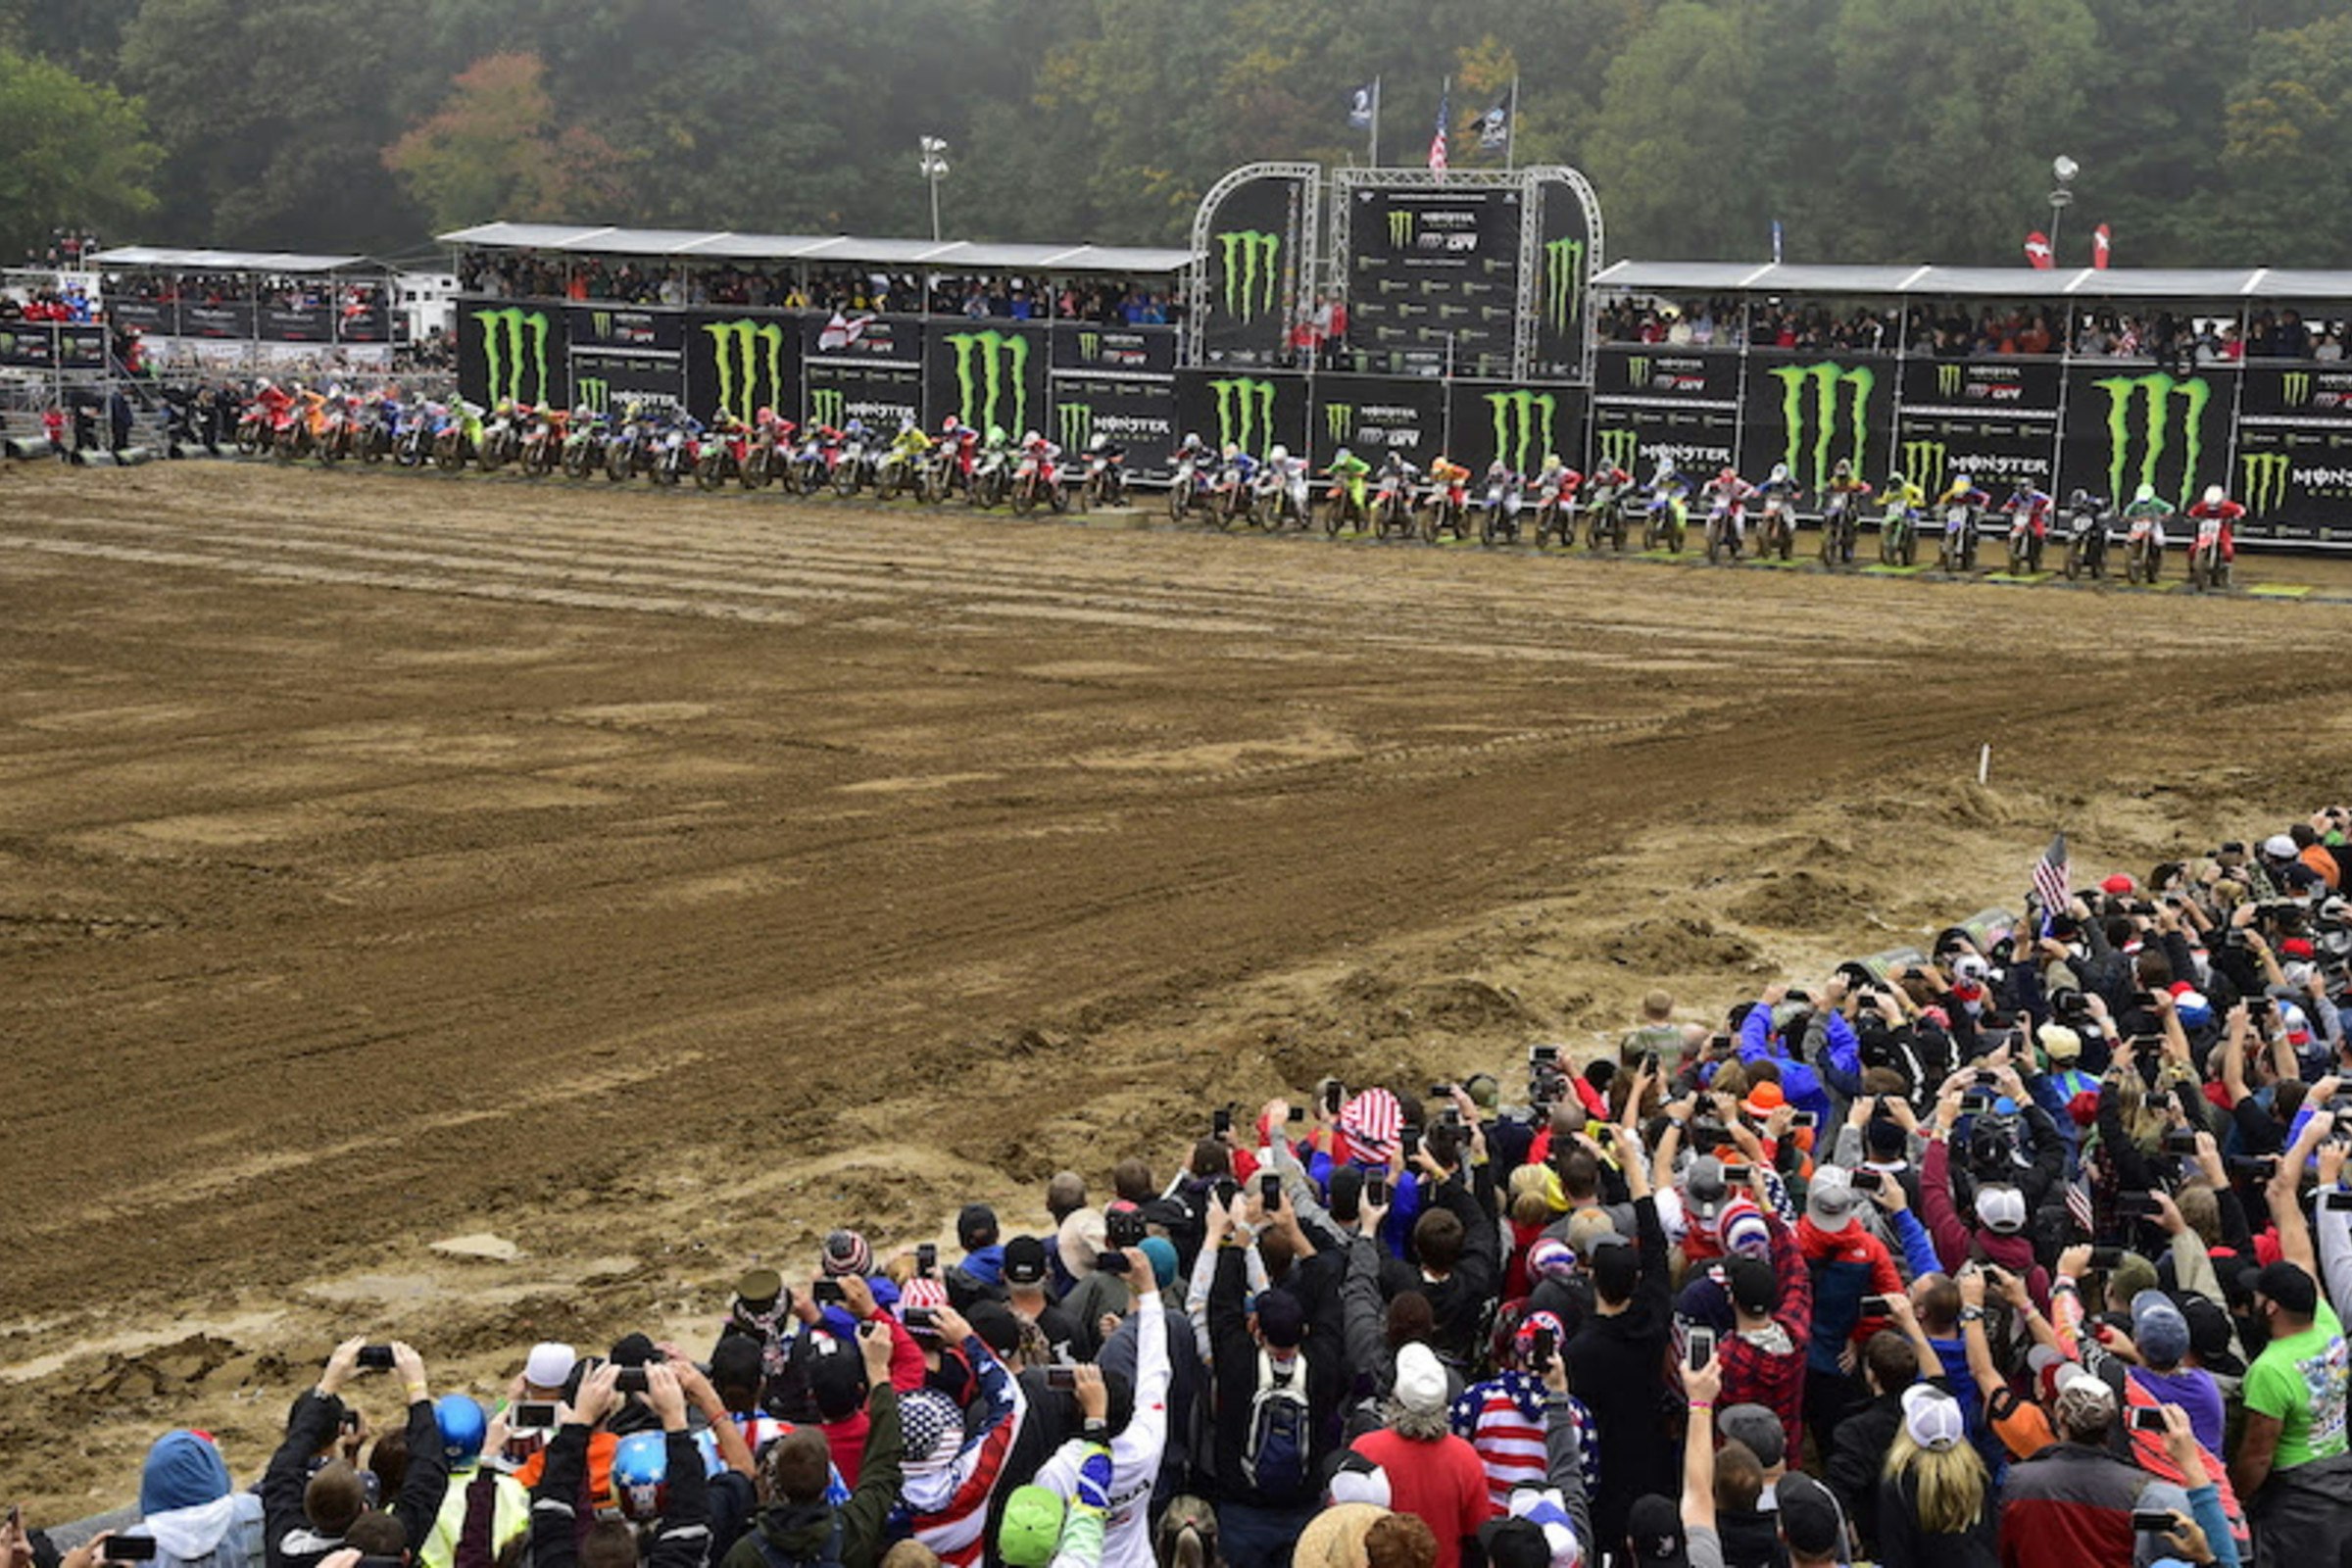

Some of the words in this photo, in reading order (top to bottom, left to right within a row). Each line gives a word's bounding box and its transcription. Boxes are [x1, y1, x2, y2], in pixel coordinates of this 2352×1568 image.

[1093, 416, 1170, 434] MONSTER
[1639, 443, 1730, 463] MONSTER
[1947, 455, 2048, 474] MONSTER
